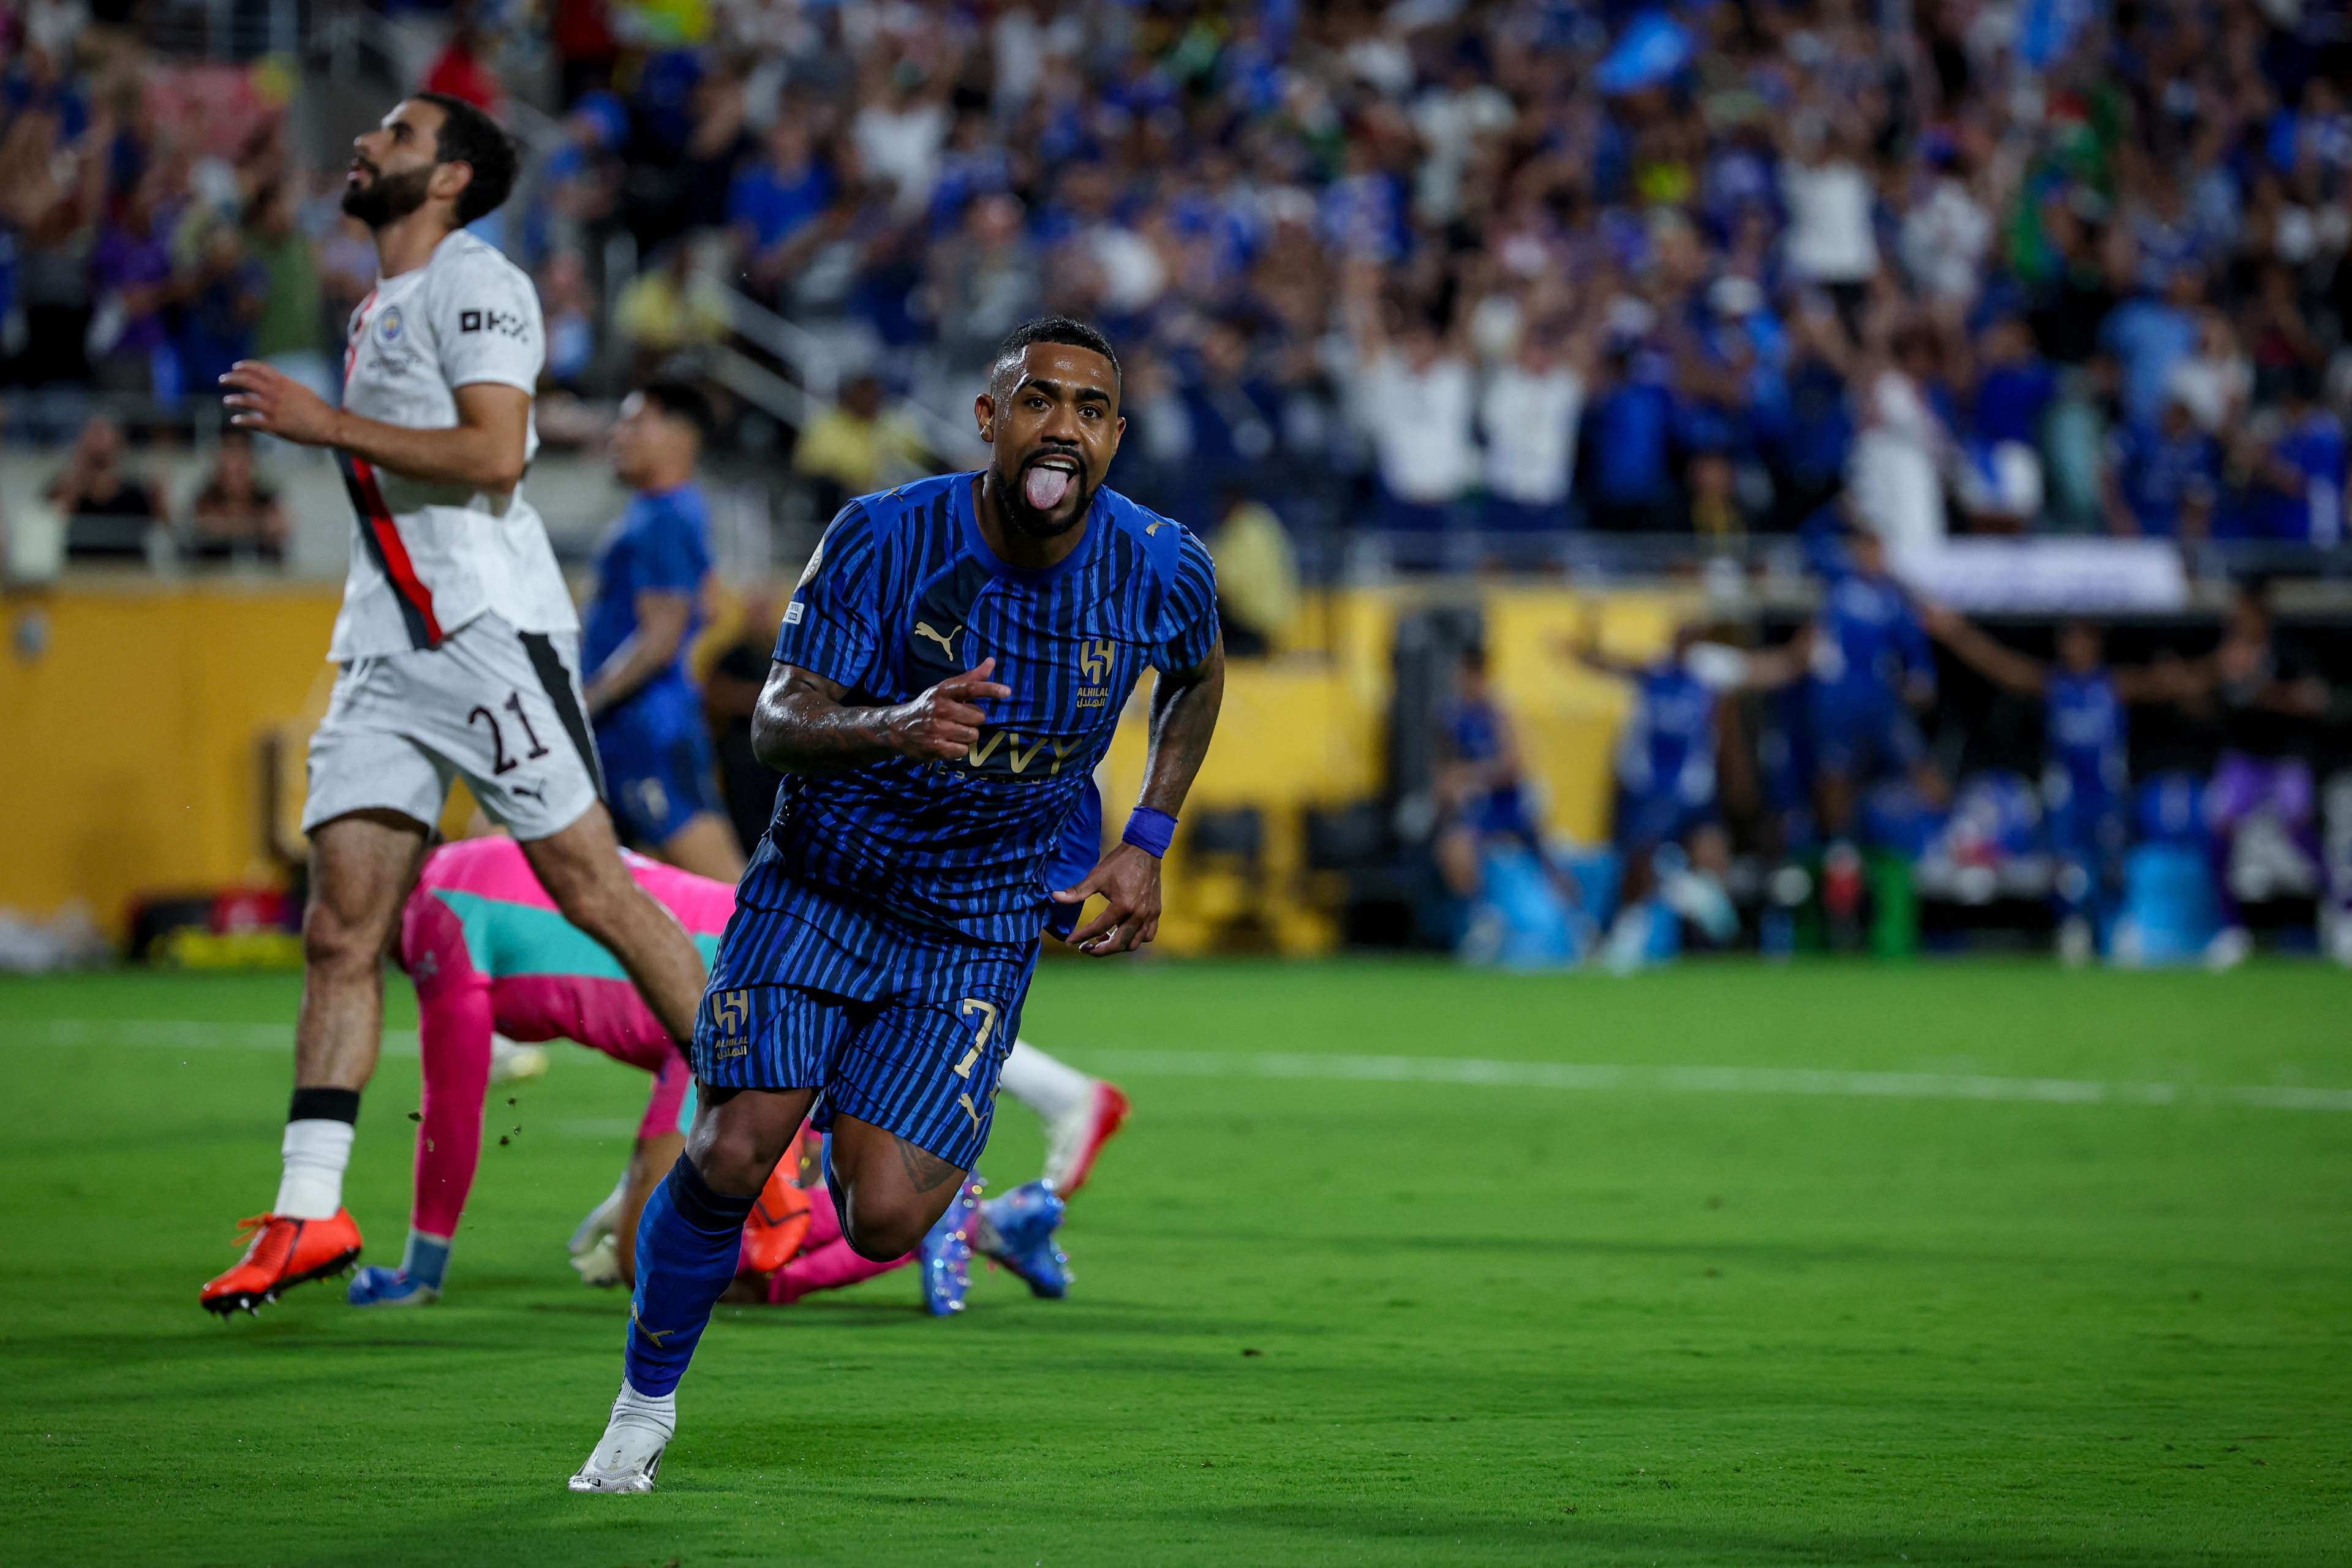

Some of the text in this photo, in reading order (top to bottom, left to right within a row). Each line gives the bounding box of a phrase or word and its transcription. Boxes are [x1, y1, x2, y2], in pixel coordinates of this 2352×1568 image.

[1077, 687, 1108, 696] ALHILAL
[469, 692, 549, 776] 21
[956, 730, 1083, 775] VVY
[953, 998, 997, 1079] 7
